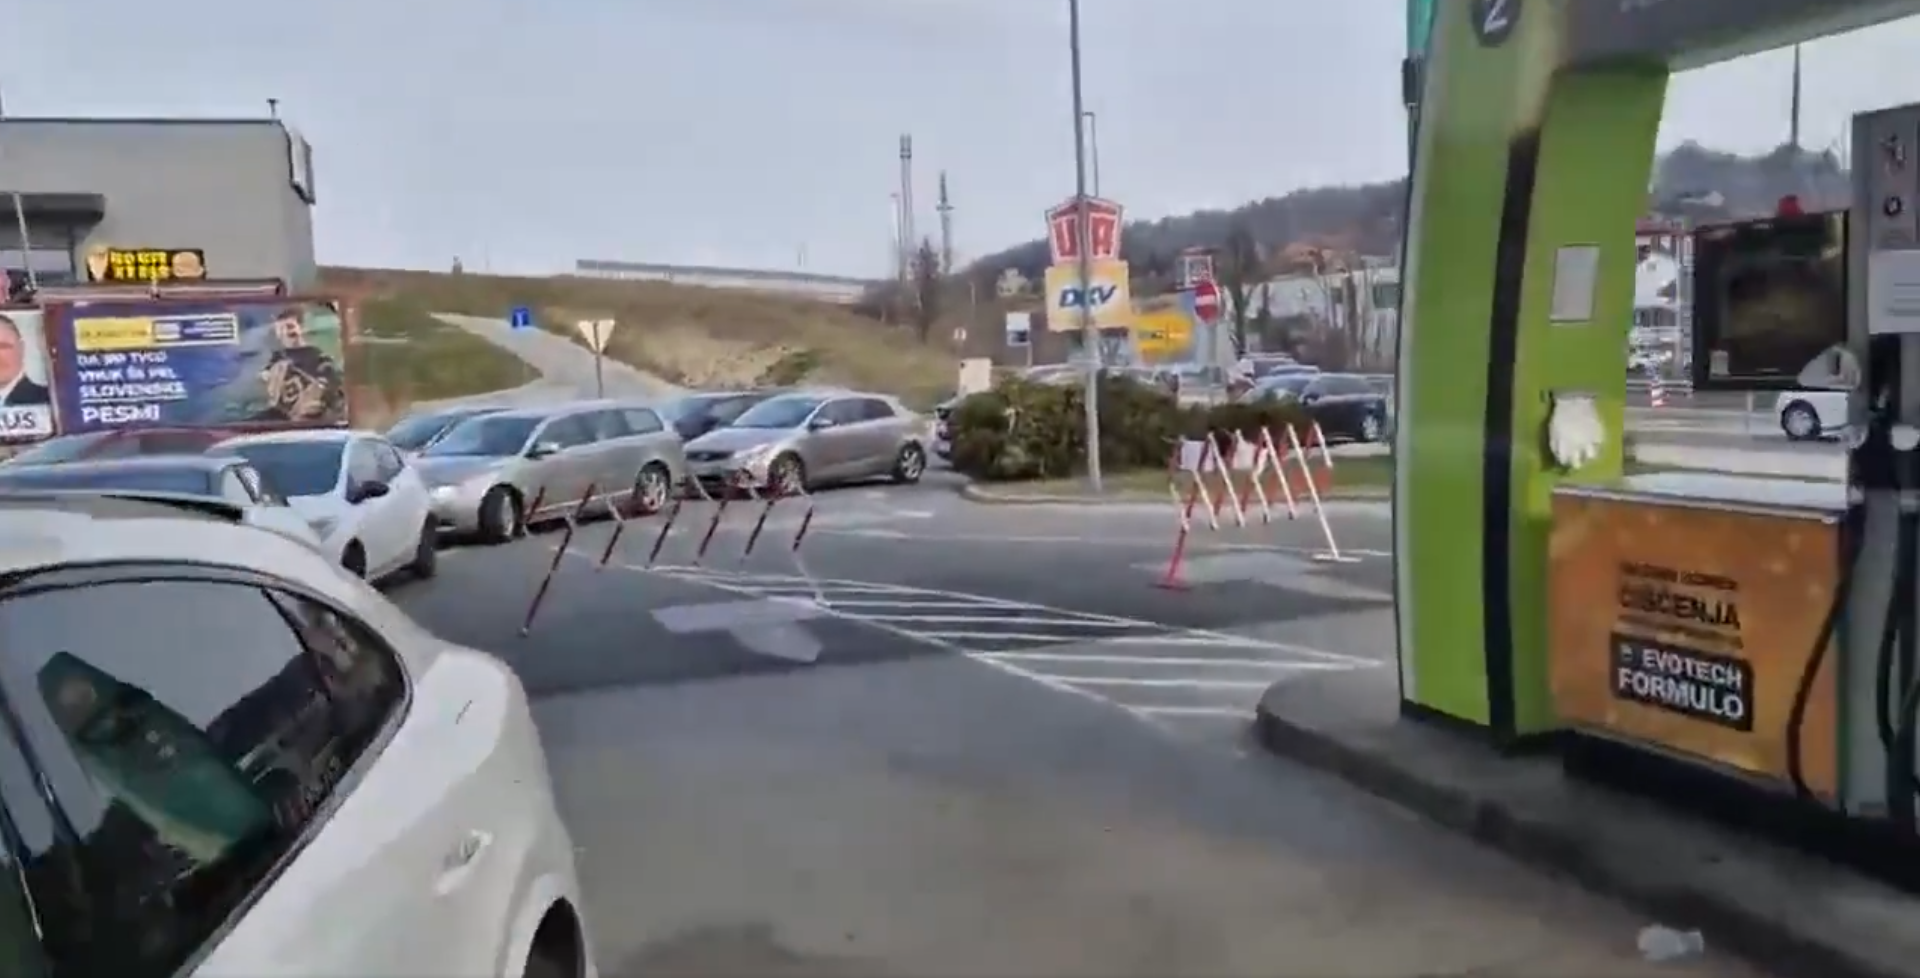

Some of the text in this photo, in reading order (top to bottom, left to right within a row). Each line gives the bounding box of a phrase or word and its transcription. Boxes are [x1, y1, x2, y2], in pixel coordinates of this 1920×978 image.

[1059, 280, 1117, 307] DKV
[80, 403, 160, 423] PESMI
[1642, 649, 1742, 688] EVOTECH
[1618, 667, 1743, 720] FORMULO
